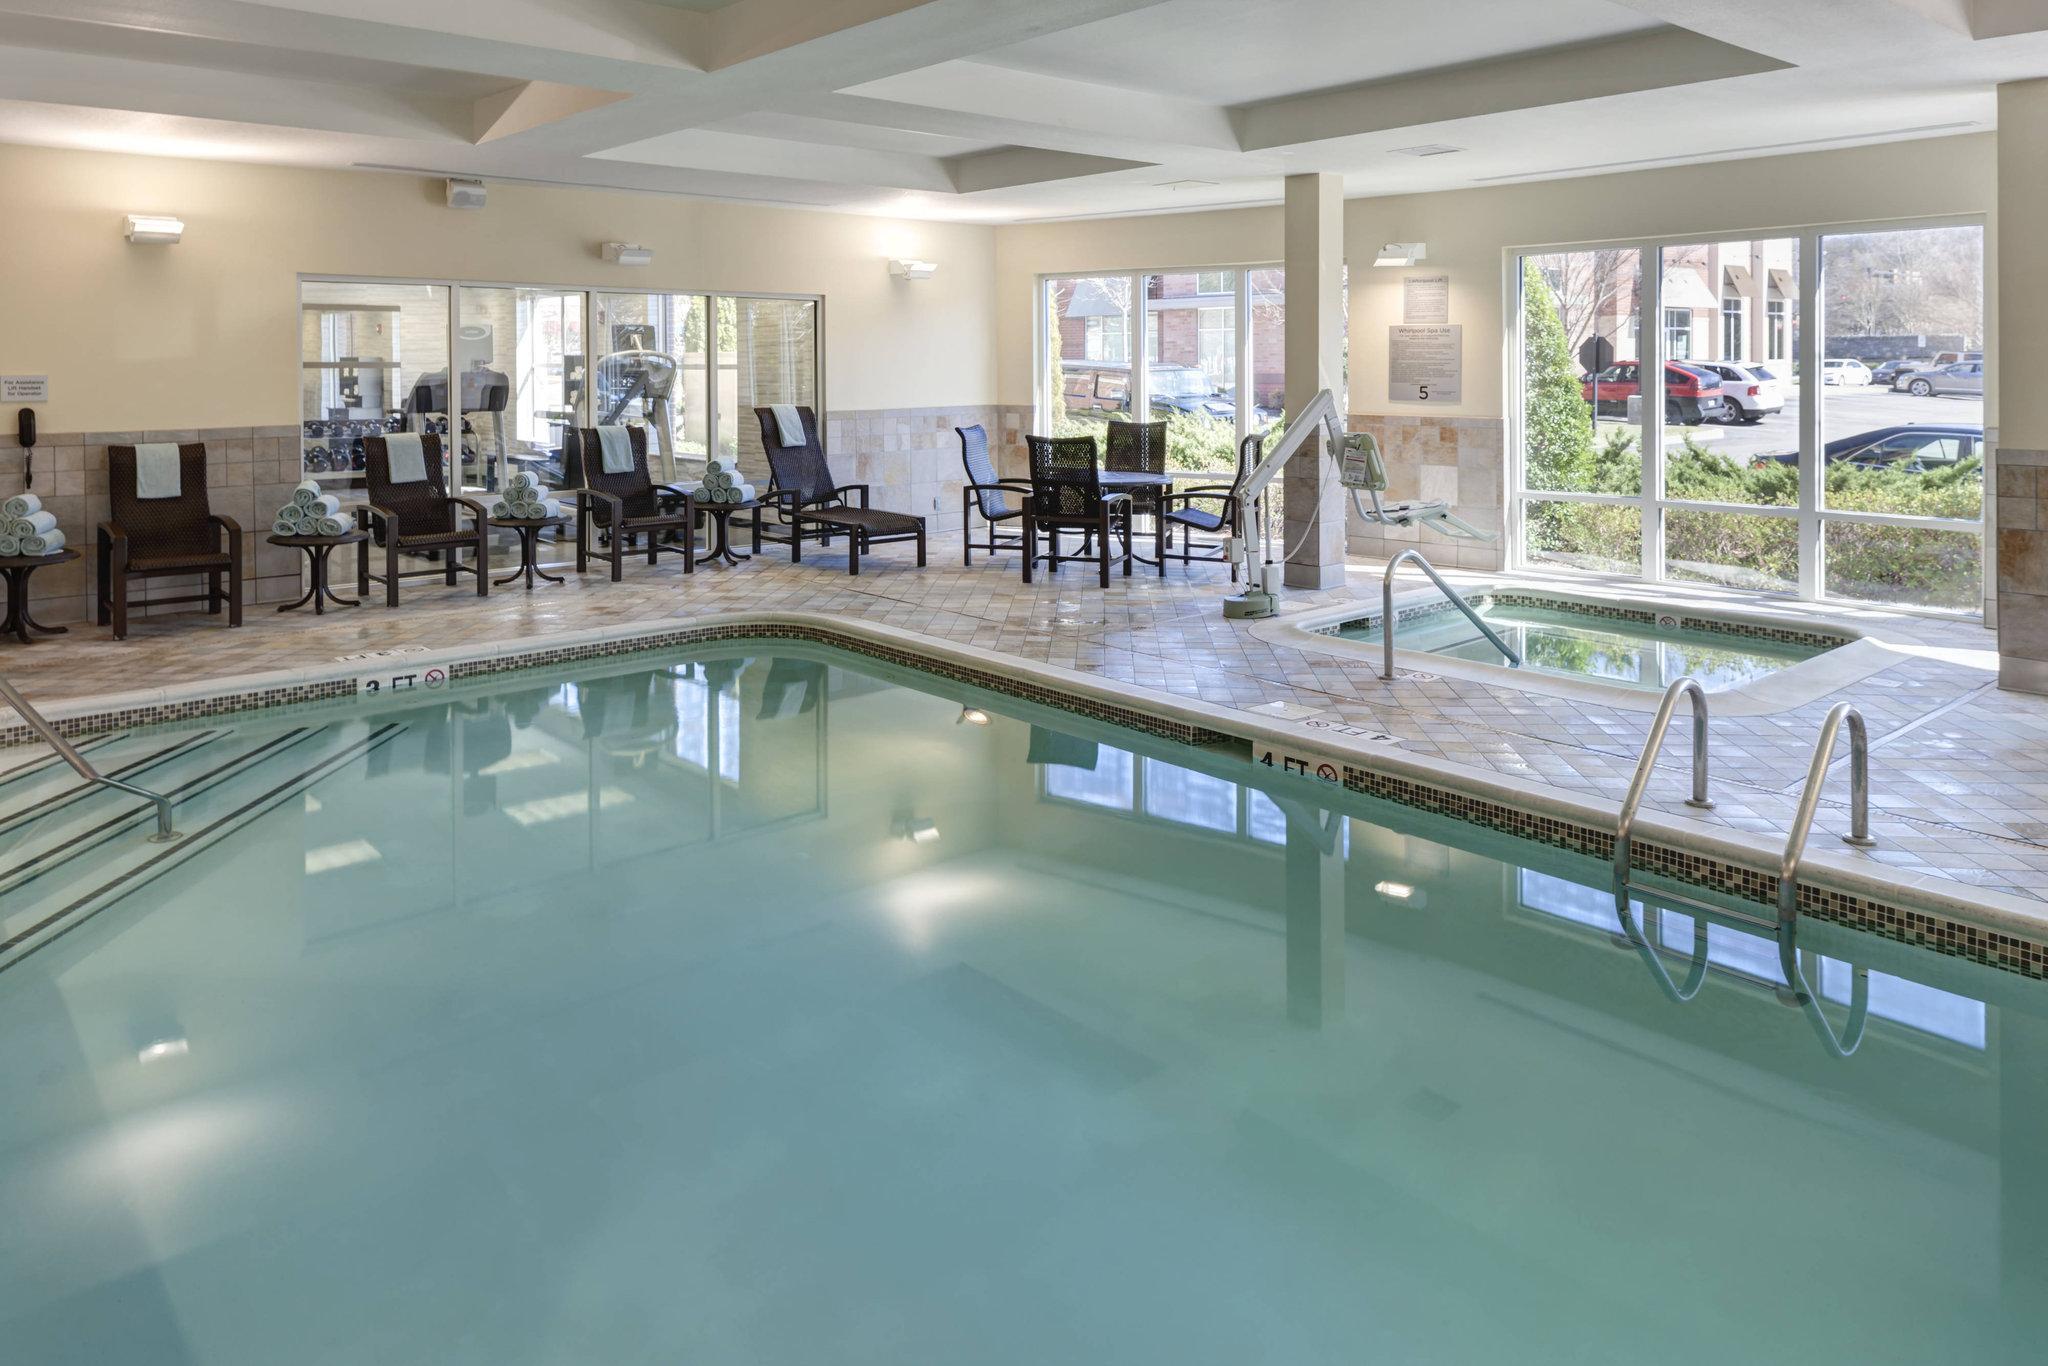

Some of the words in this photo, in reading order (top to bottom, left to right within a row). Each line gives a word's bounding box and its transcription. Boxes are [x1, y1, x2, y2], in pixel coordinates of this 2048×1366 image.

[1418, 386, 1429, 400] 5
[1259, 751, 1274, 767] 4
[1284, 756, 1309, 776] FT
